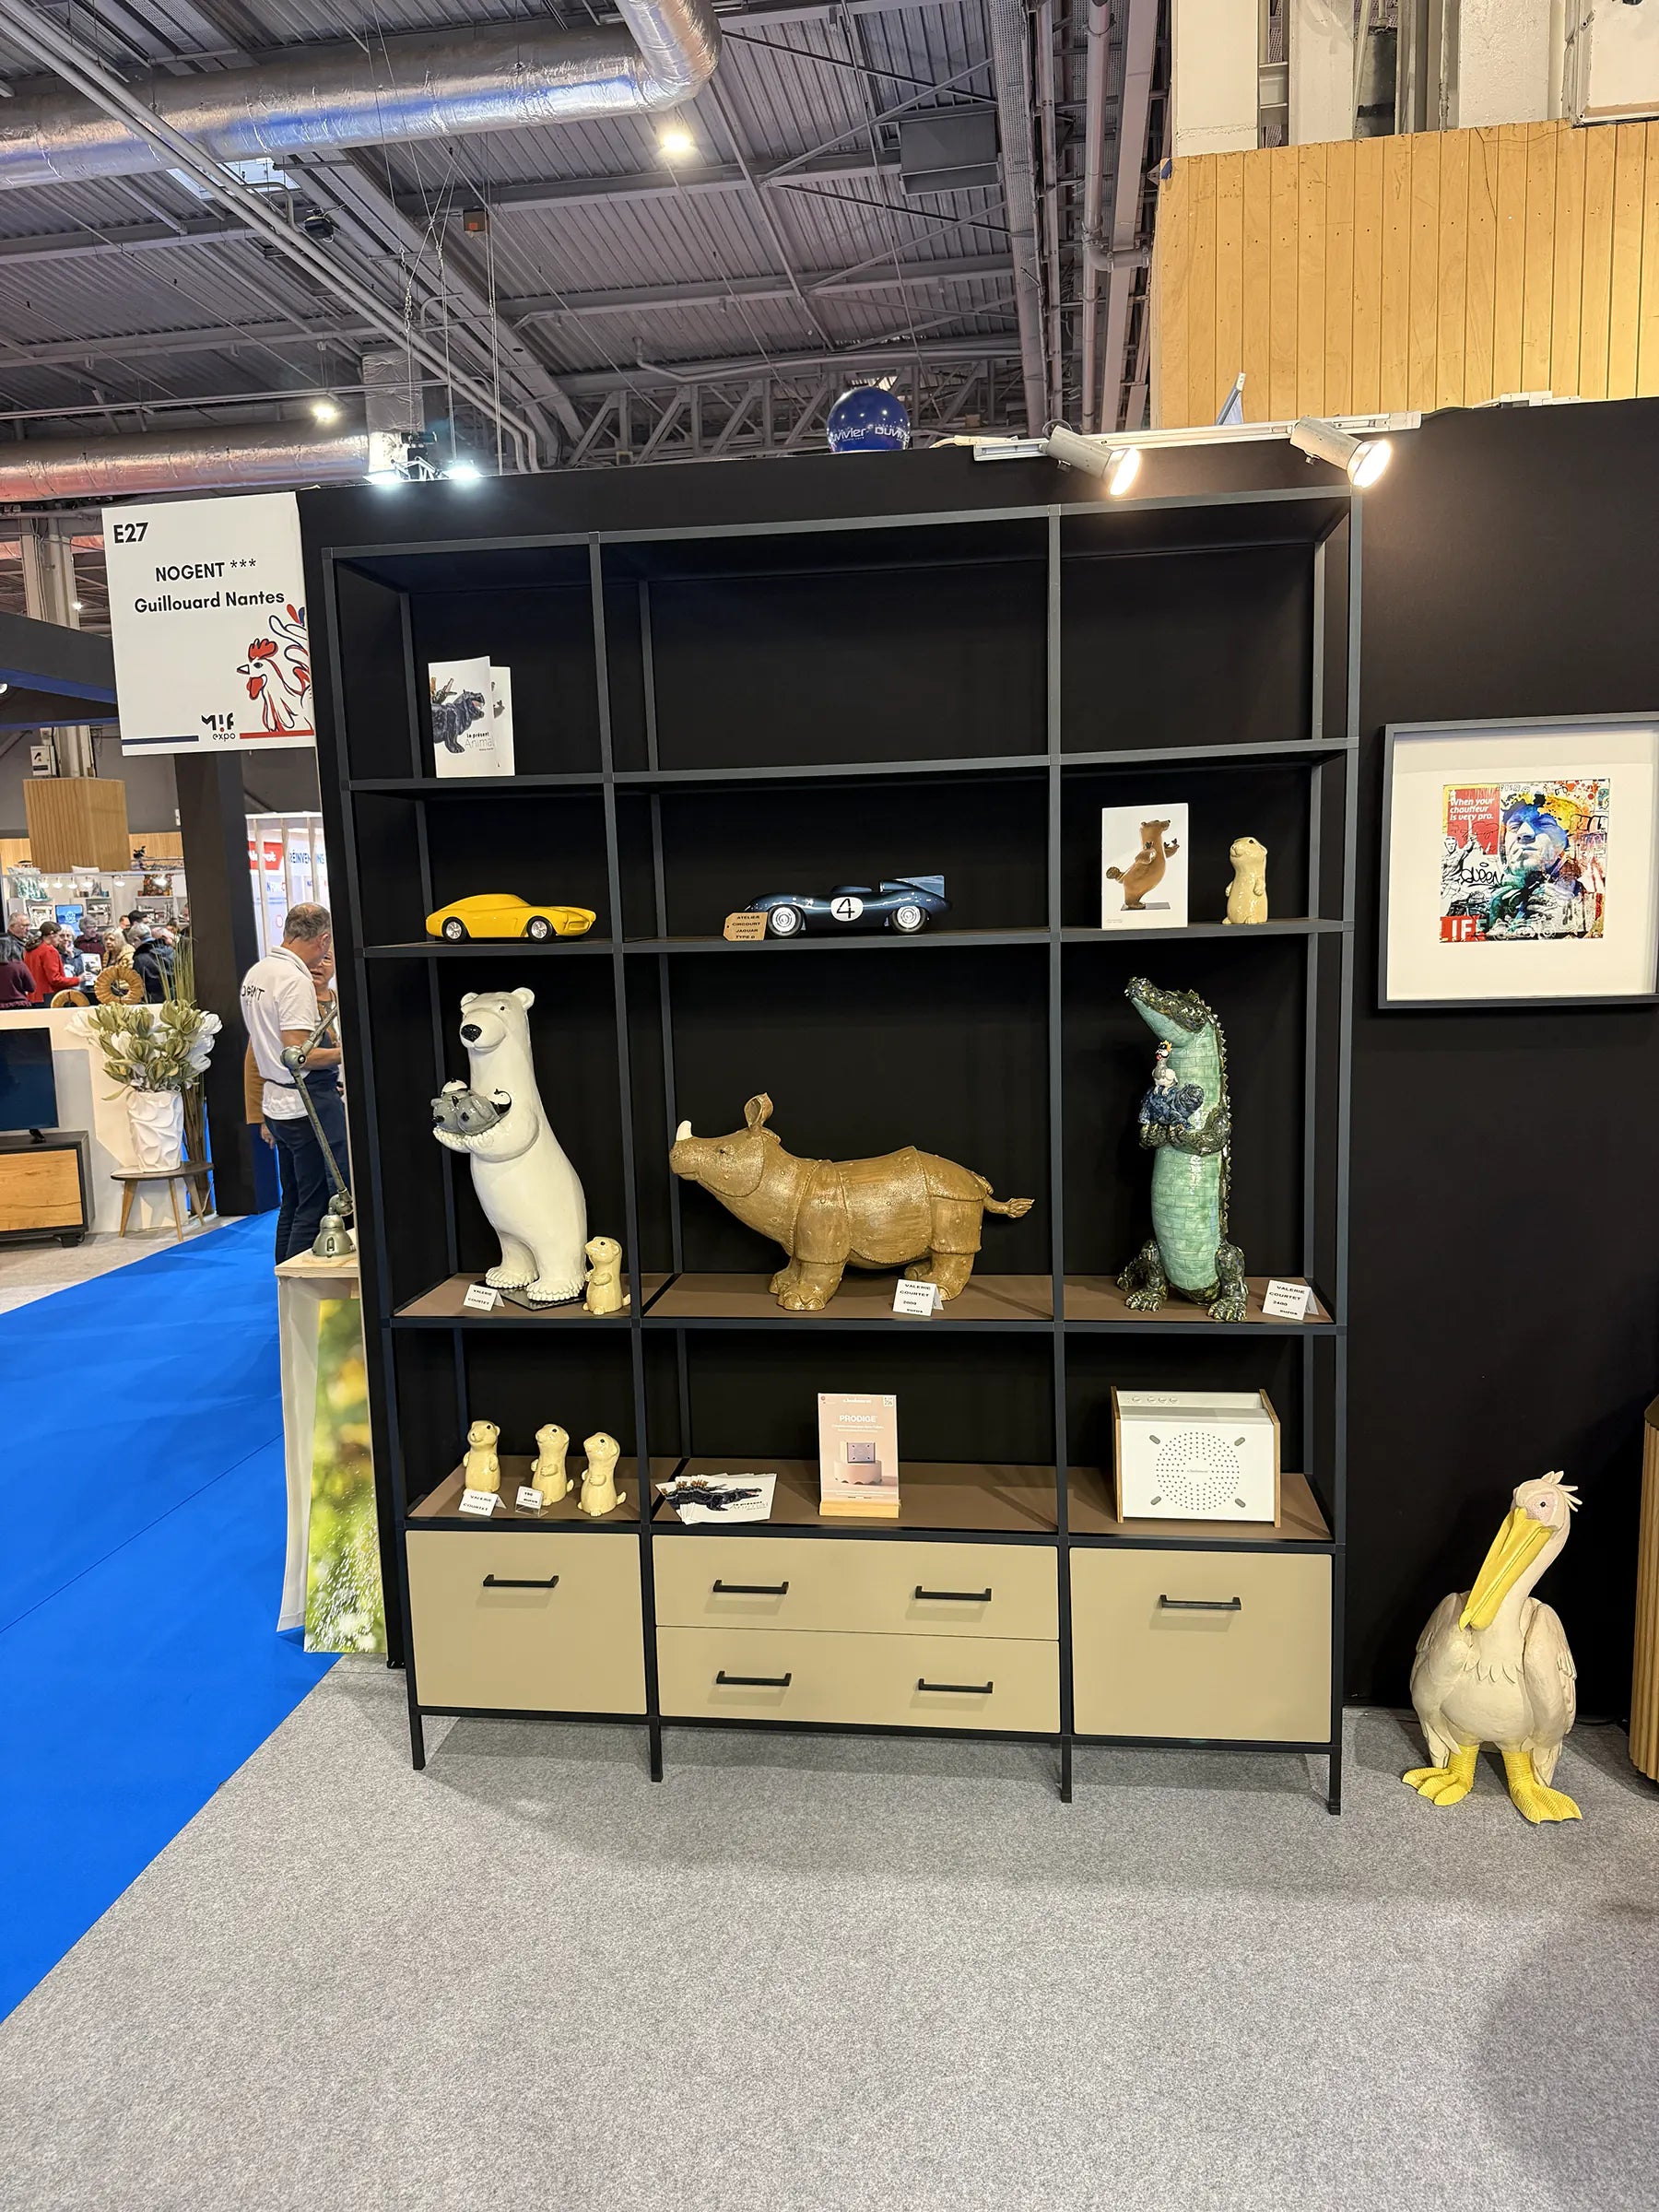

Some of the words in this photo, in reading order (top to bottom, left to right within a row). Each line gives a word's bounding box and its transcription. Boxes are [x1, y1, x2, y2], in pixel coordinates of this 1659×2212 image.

[113, 522, 148, 544] E27
[156, 561, 225, 582] NOGENT
[135, 592, 220, 614] Guillouard
[225, 590, 285, 608] Nantes
[212, 733, 236, 742] expo
[1475, 798, 1495, 808] your
[836, 898, 855, 919] 4
[840, 1414, 877, 1423] PRODIGE
